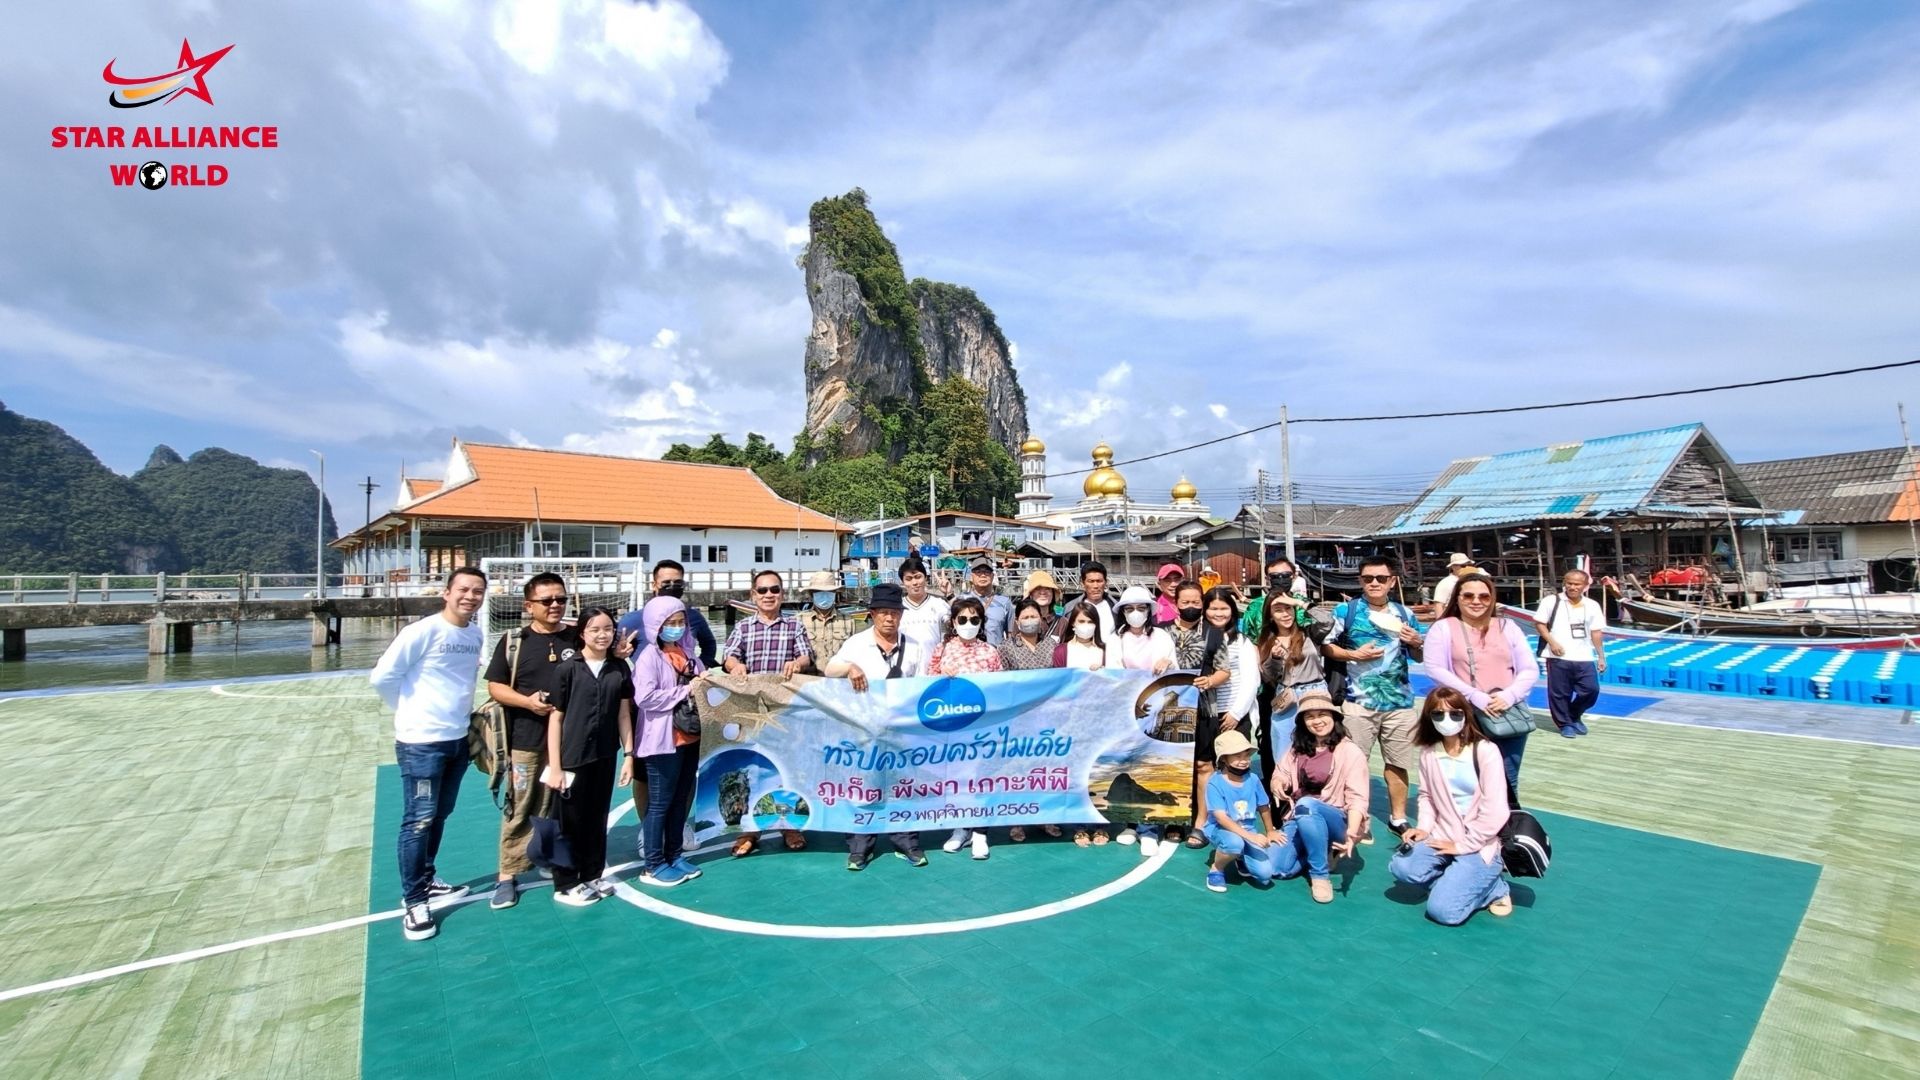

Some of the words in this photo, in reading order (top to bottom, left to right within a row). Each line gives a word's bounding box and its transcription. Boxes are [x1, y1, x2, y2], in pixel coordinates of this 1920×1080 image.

[926, 699, 982, 717] Midea
[823, 726, 1073, 772] ทริปครอบครัวไมเดีย
[817, 777, 882, 807] ภูเก็ต
[892, 779, 958, 799] พังงา
[968, 767, 1069, 793] เกาะพีพี
[854, 812, 875, 826] 27
[889, 811, 911, 823] 29
[914, 803, 994, 823] พฤศจิกายน
[997, 802, 1040, 817] 2565
